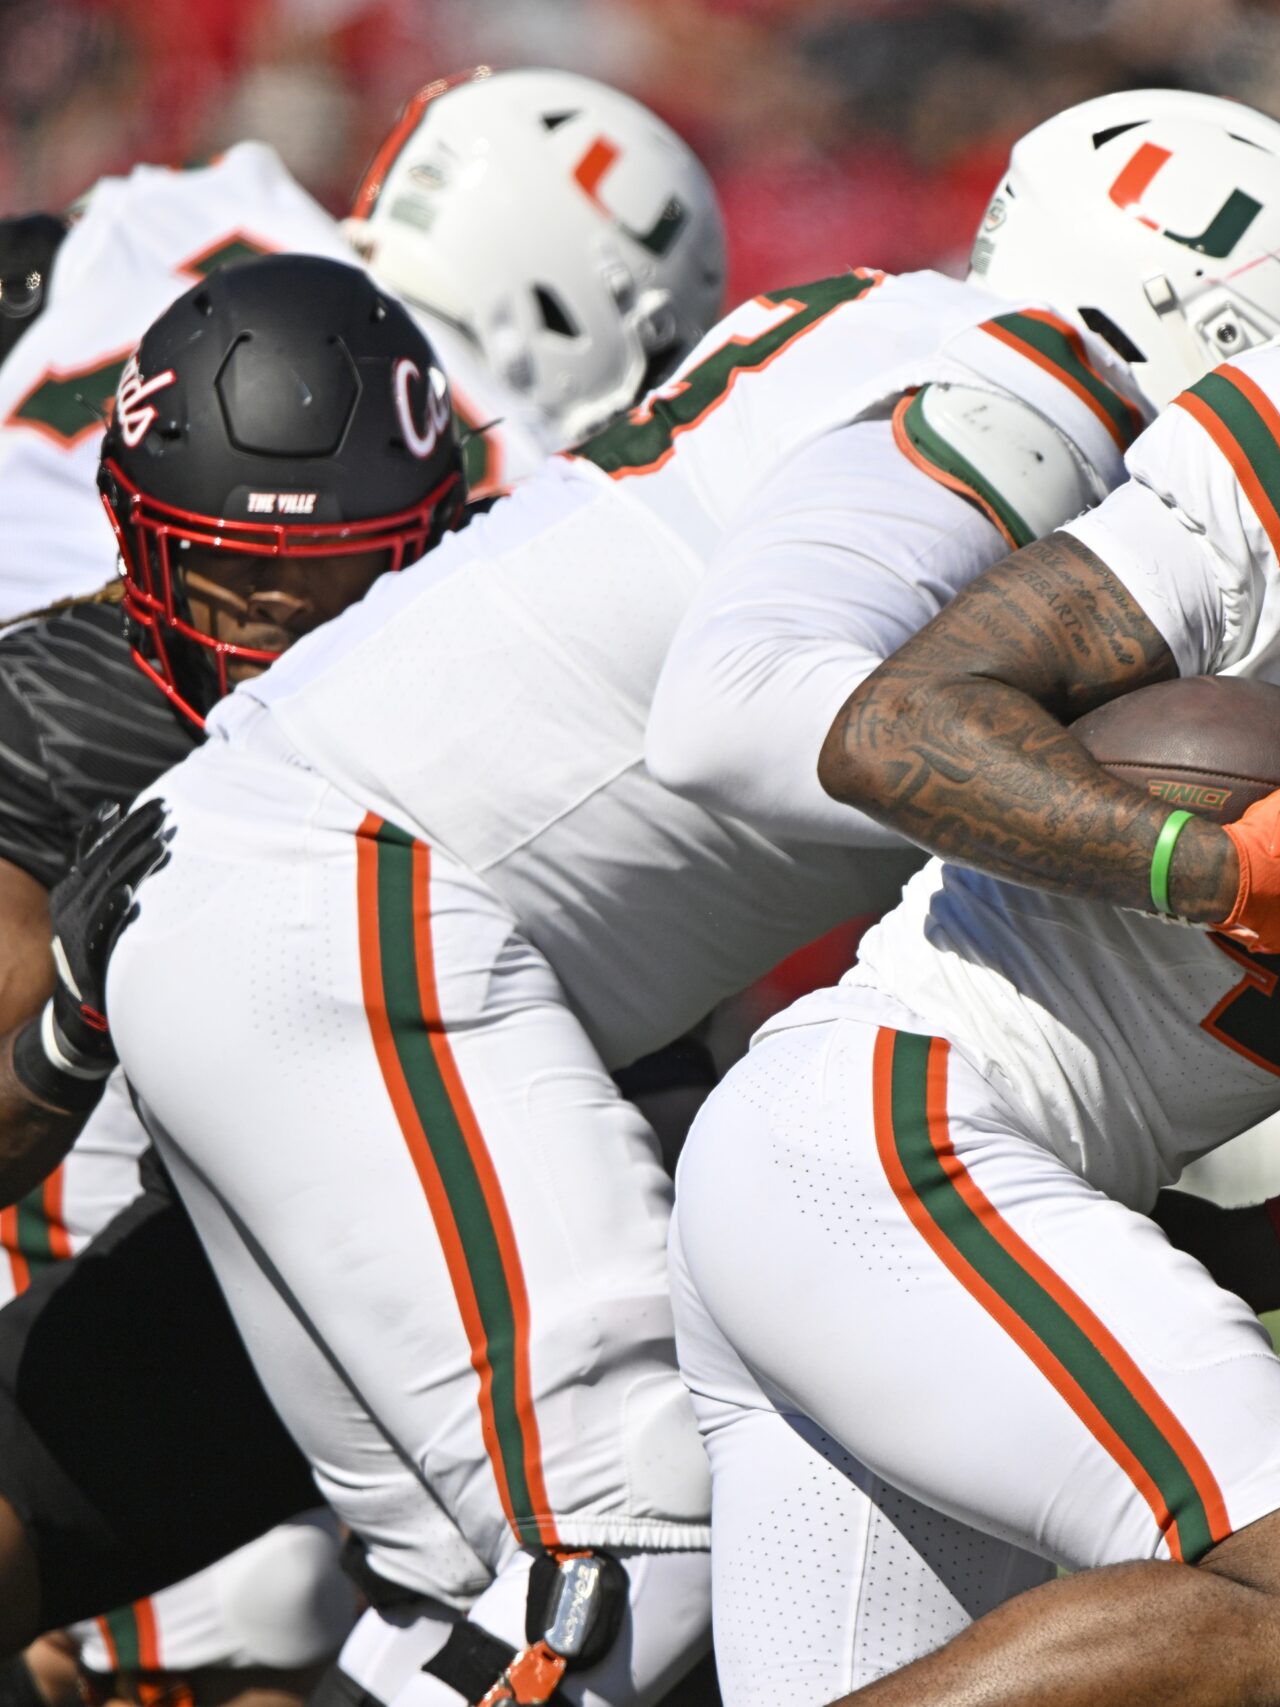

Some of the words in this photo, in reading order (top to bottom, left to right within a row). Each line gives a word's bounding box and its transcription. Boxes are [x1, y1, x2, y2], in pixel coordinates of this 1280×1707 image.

[246, 492, 277, 514] THE
[277, 492, 318, 515] VILLE
[1147, 780, 1232, 811] DIME
